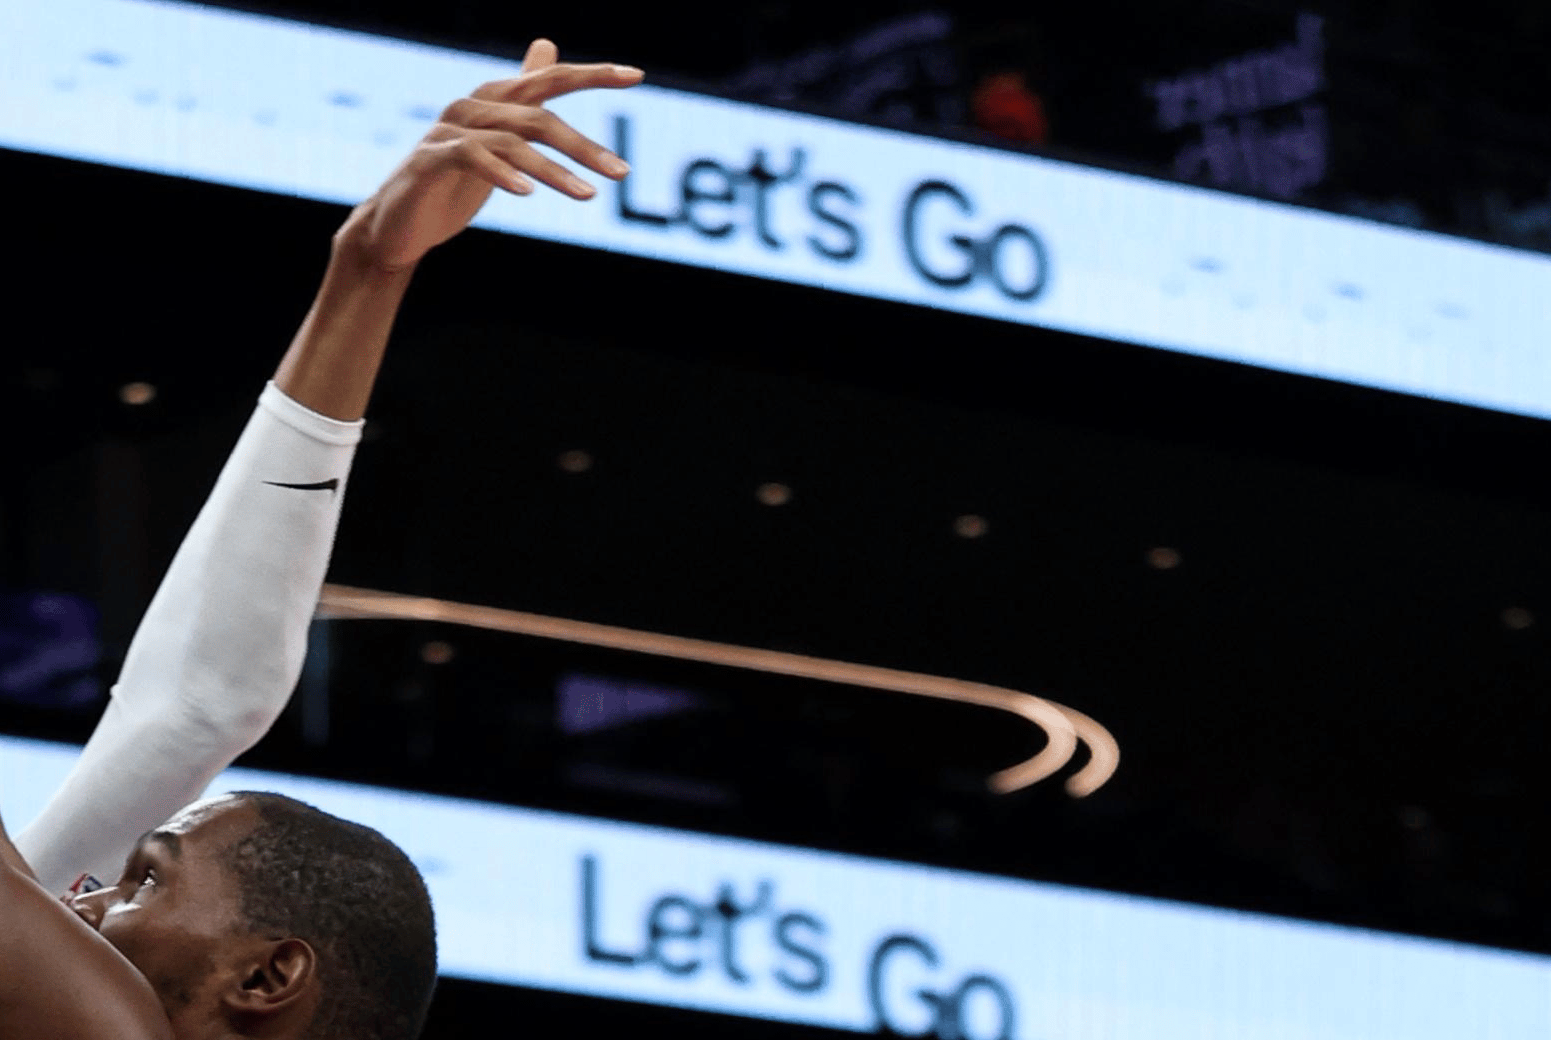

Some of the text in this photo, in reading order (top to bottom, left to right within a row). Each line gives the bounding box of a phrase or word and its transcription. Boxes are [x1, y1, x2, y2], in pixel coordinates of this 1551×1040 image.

[614, 114, 1049, 301] Let's Go
[582, 854, 828, 992] Let's
